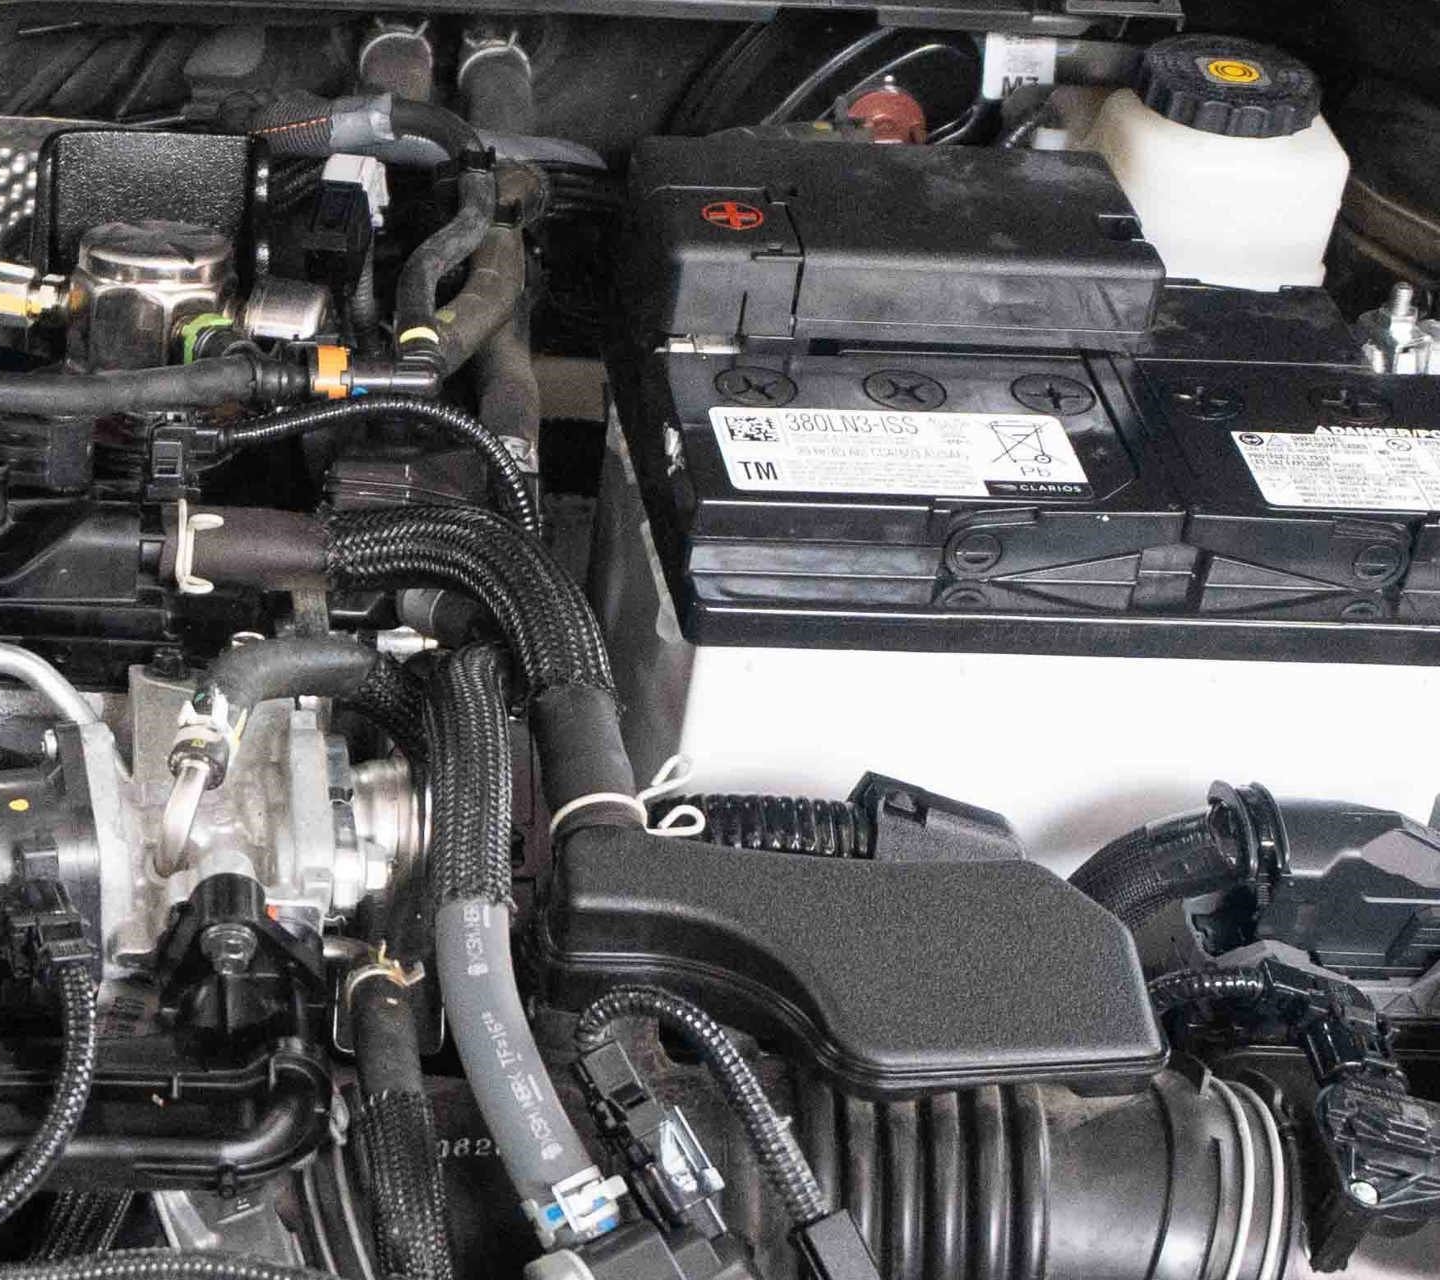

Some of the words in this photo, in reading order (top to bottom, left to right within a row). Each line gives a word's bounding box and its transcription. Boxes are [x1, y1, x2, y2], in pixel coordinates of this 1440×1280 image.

[785, 413, 919, 436] 380LN3-ISS
[737, 460, 779, 482] TM
[1020, 484, 1081, 493] CLARIOS
